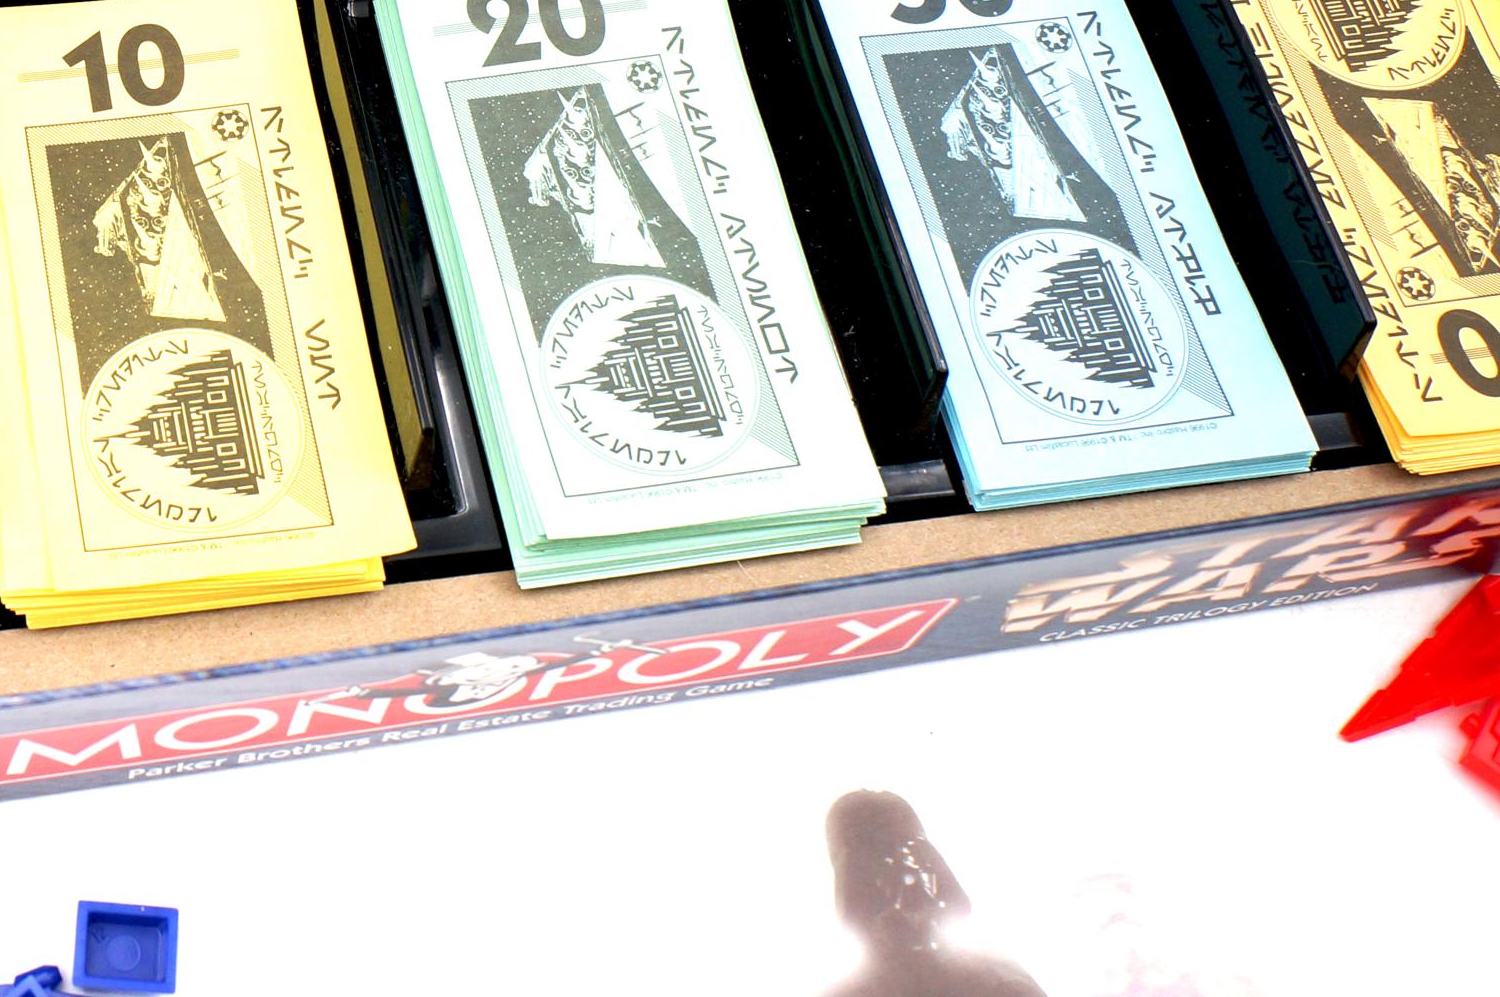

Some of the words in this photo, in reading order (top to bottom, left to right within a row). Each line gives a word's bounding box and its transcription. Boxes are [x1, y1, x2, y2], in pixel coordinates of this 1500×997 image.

[62, 22, 186, 113] 10
[1038, 618, 1148, 643] CLASSIC
[1153, 599, 1268, 626] TRILOGY
[1269, 583, 1379, 608] EDITION
[128, 757, 228, 782] Parker
[237, 736, 371, 764] Brothers
[382, 723, 449, 743] Real
[457, 708, 552, 731] Estate
[564, 690, 677, 718] Trading
[684, 675, 776, 699] Game
